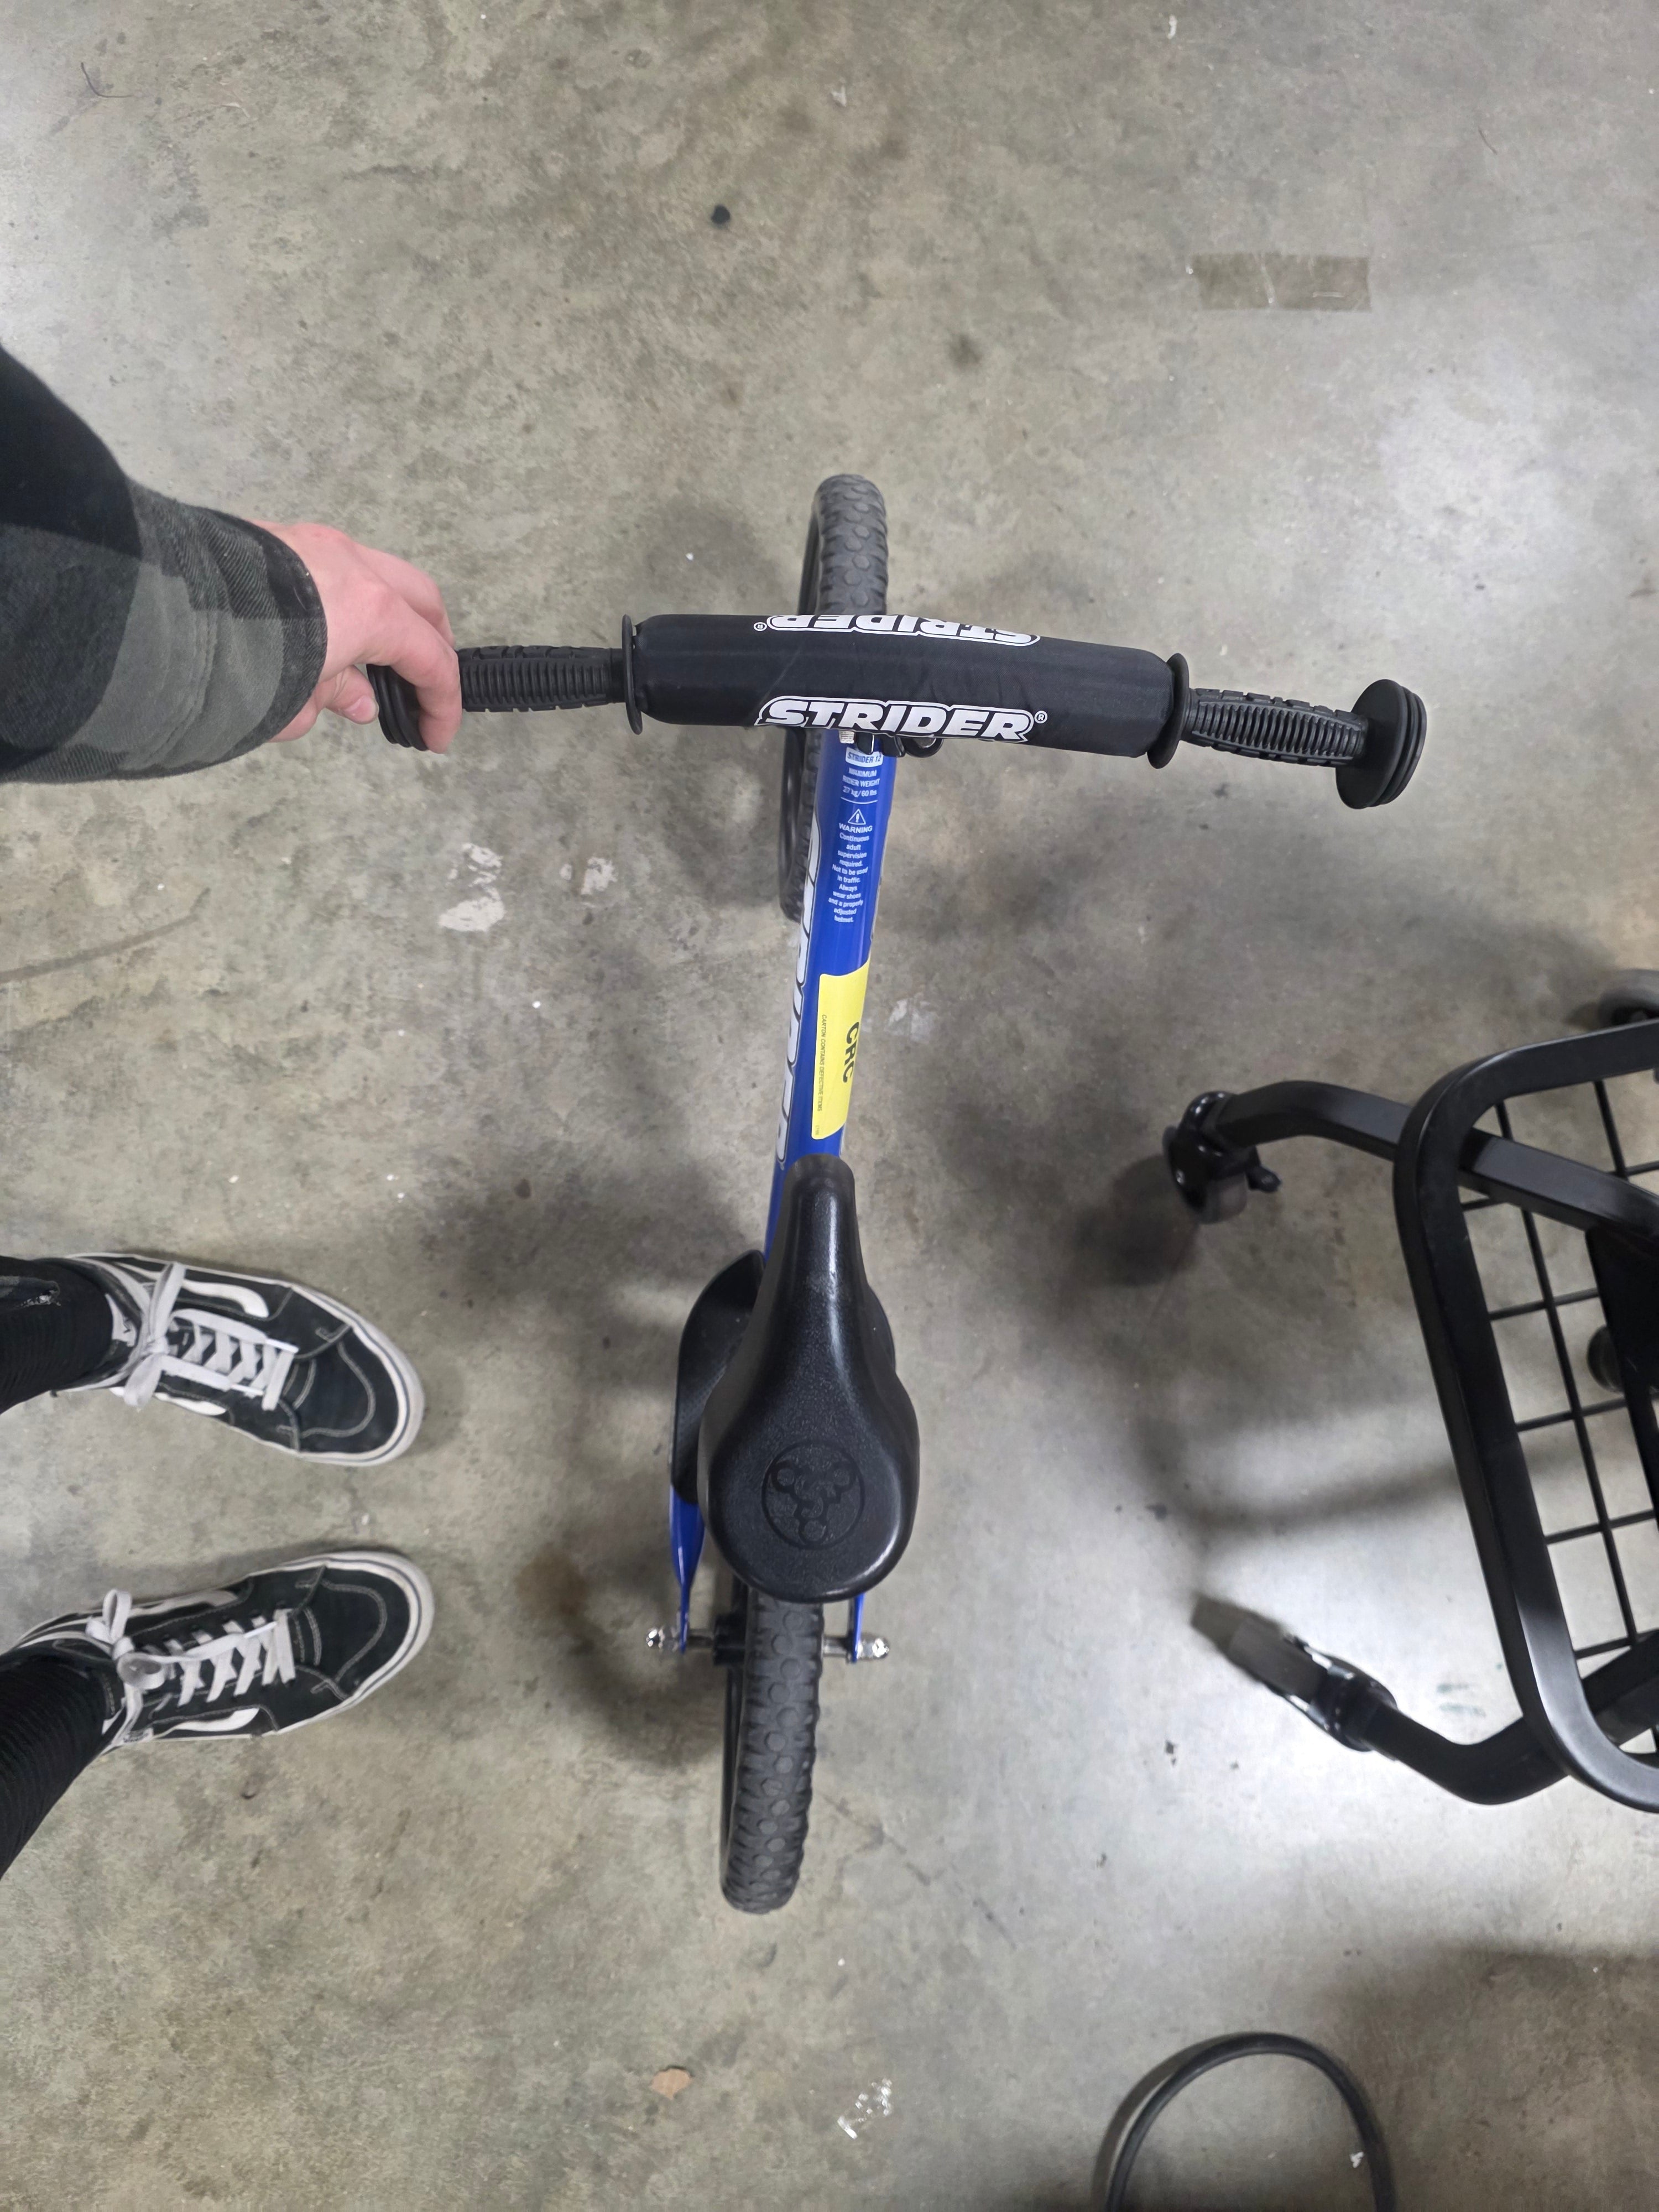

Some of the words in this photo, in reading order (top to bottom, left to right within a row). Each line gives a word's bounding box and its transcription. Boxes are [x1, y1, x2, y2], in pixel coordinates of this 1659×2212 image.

[875, 754, 882, 763] 12
[860, 778, 880, 787] WEIGHT
[839, 823, 873, 833] WARNING
[839, 832, 869, 842] Continuous
[837, 850, 867, 859] supervision
[832, 864, 842, 873] Not
[856, 867, 868, 875] used
[839, 884, 857, 892] Always
[843, 899, 863, 907] properly
[842, 1021, 859, 1083] CRC
